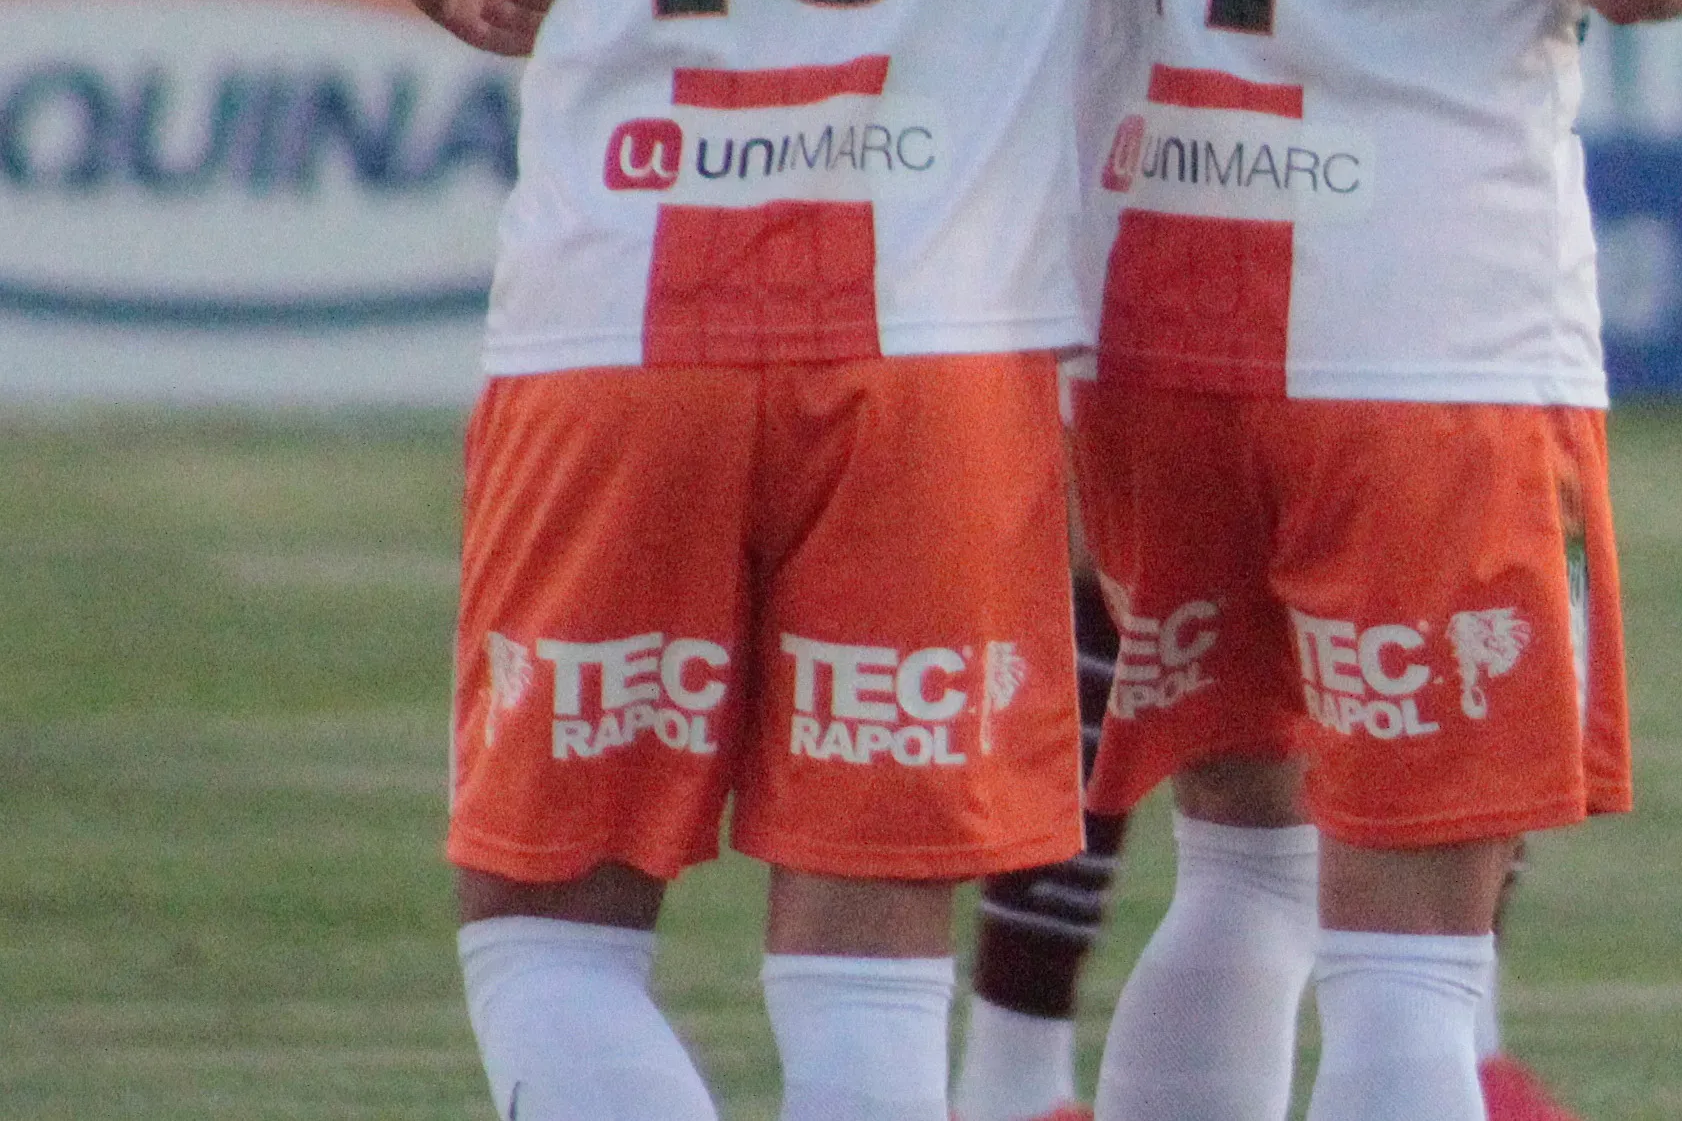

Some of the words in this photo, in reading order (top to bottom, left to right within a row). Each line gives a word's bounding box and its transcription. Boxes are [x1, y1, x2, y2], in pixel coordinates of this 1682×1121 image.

[537, 632, 729, 716] TEC
[780, 632, 967, 720] TEC
[1112, 594, 1219, 681] EC
[1290, 608, 1430, 696] TEC
[552, 703, 718, 762] RAPOL
[791, 717, 967, 767] RAPOL
